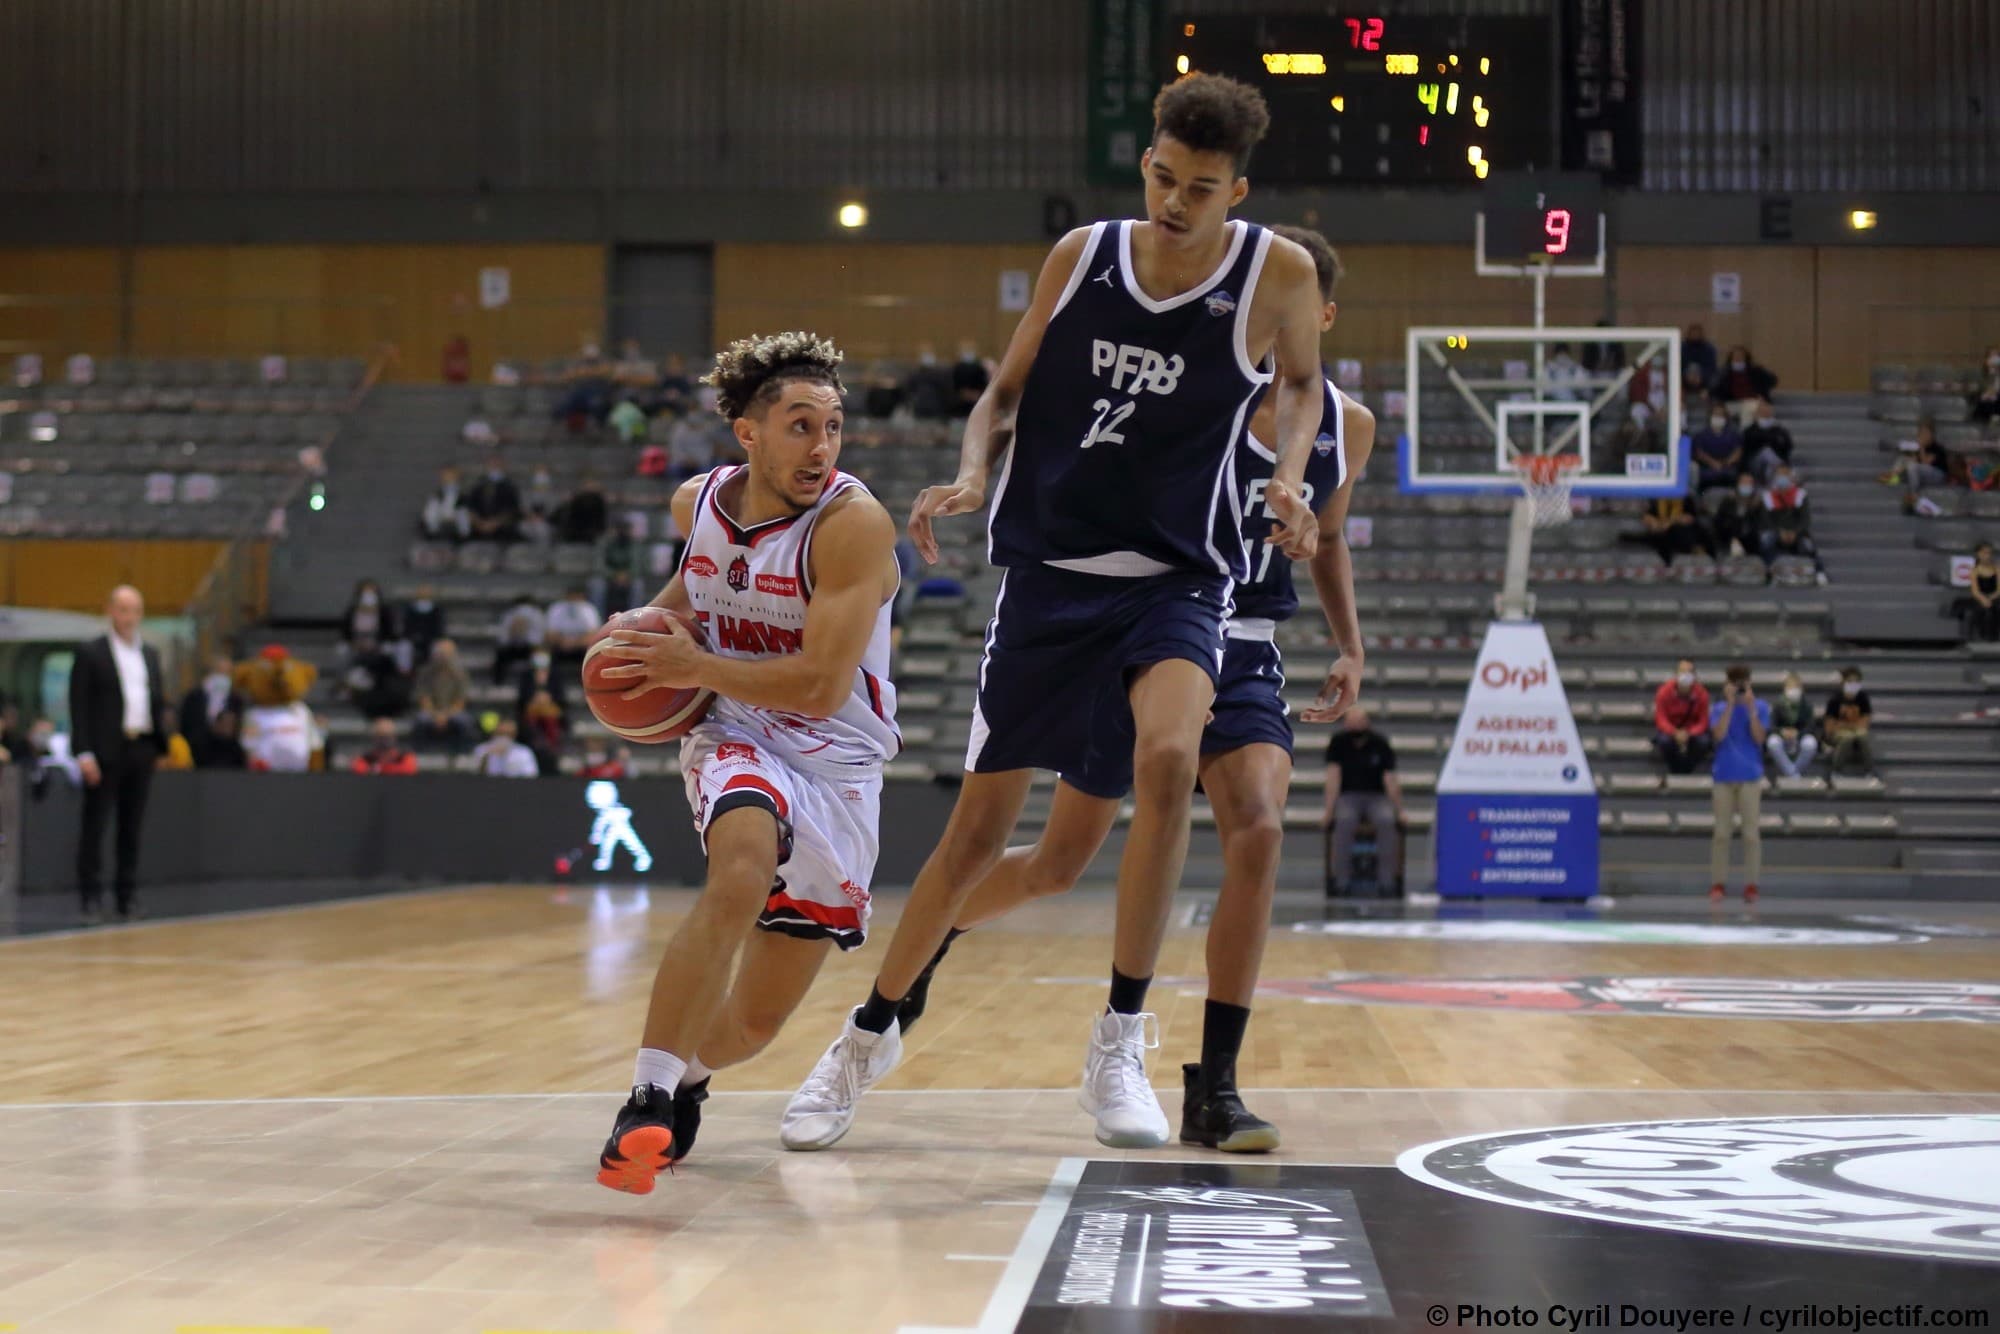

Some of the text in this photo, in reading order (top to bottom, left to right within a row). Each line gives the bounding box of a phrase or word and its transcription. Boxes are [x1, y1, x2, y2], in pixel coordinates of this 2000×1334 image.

[1345, 18, 1384, 51] 72
[1544, 208, 1571, 254] 9
[1481, 659, 1548, 693] Orpi
[1475, 715, 1558, 733] AGENCE
[1465, 738, 1568, 756] DU PALAIS
